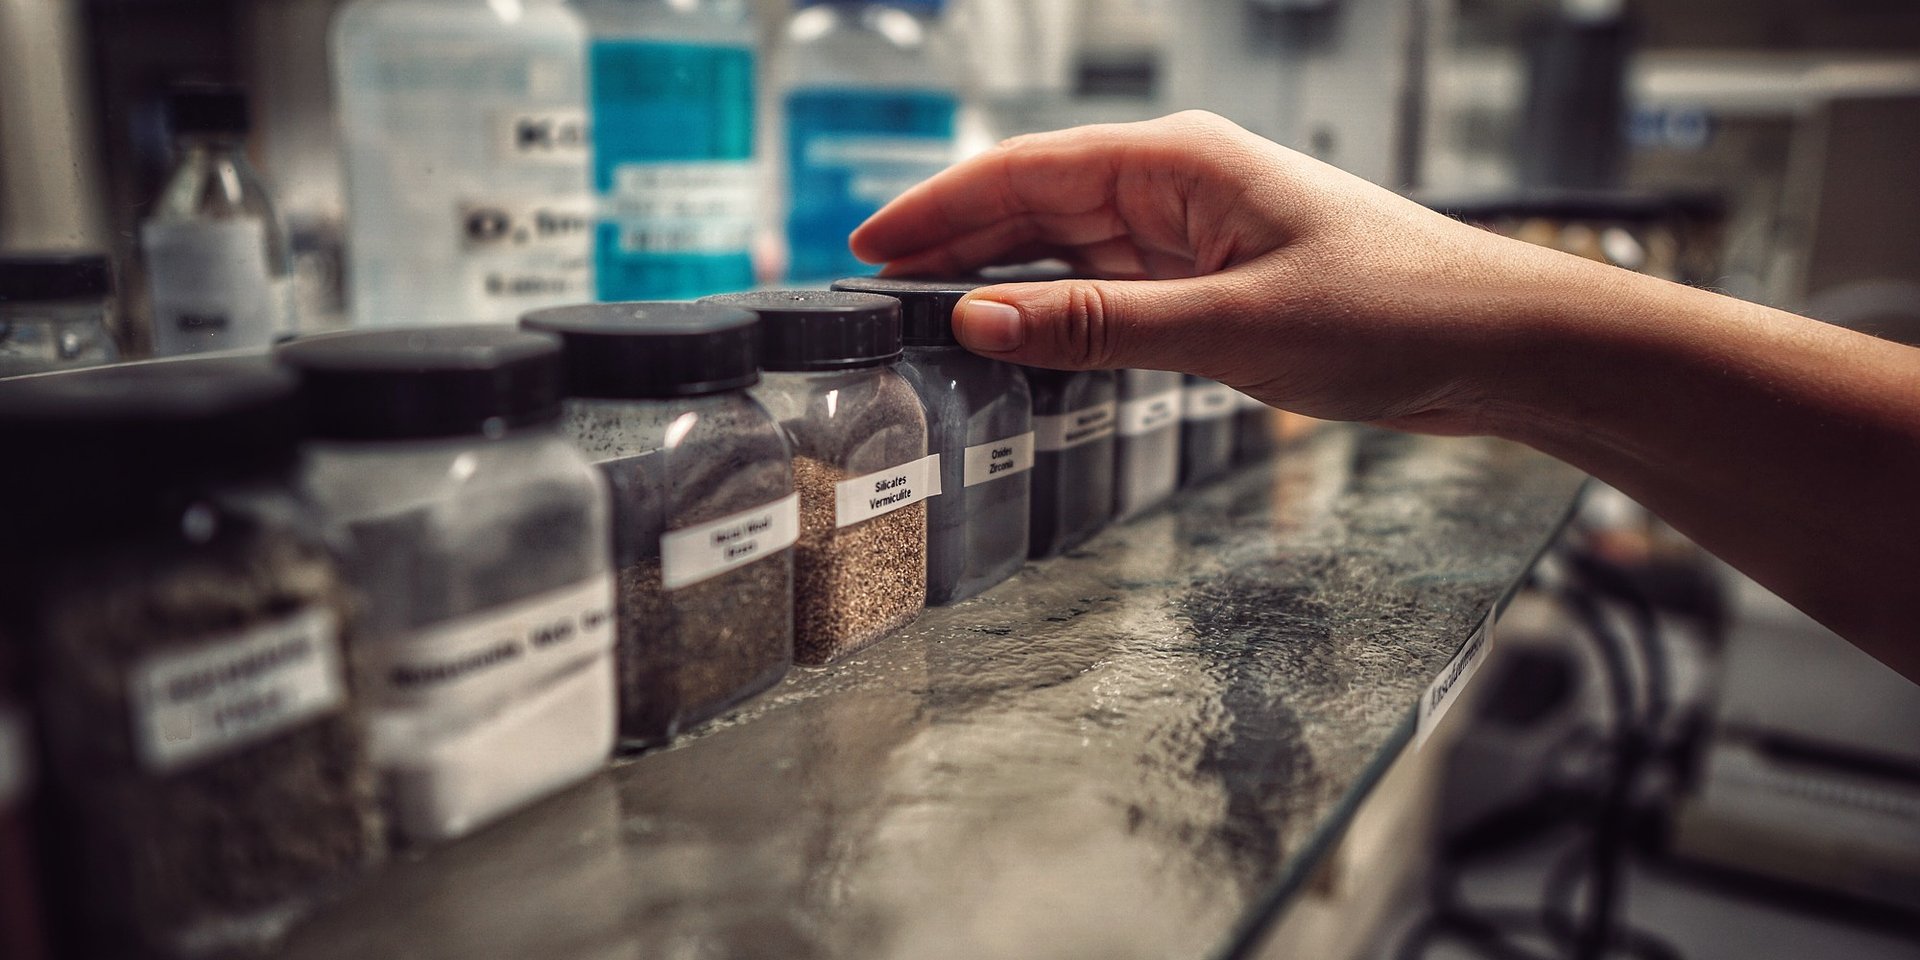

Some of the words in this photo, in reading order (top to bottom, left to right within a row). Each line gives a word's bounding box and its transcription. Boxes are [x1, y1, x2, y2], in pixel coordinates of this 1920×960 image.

[991, 447, 1013, 460] Oxides
[989, 460, 1014, 474] Zirconia
[875, 475, 907, 493] Silicates
[869, 488, 912, 510] Vermiculite
